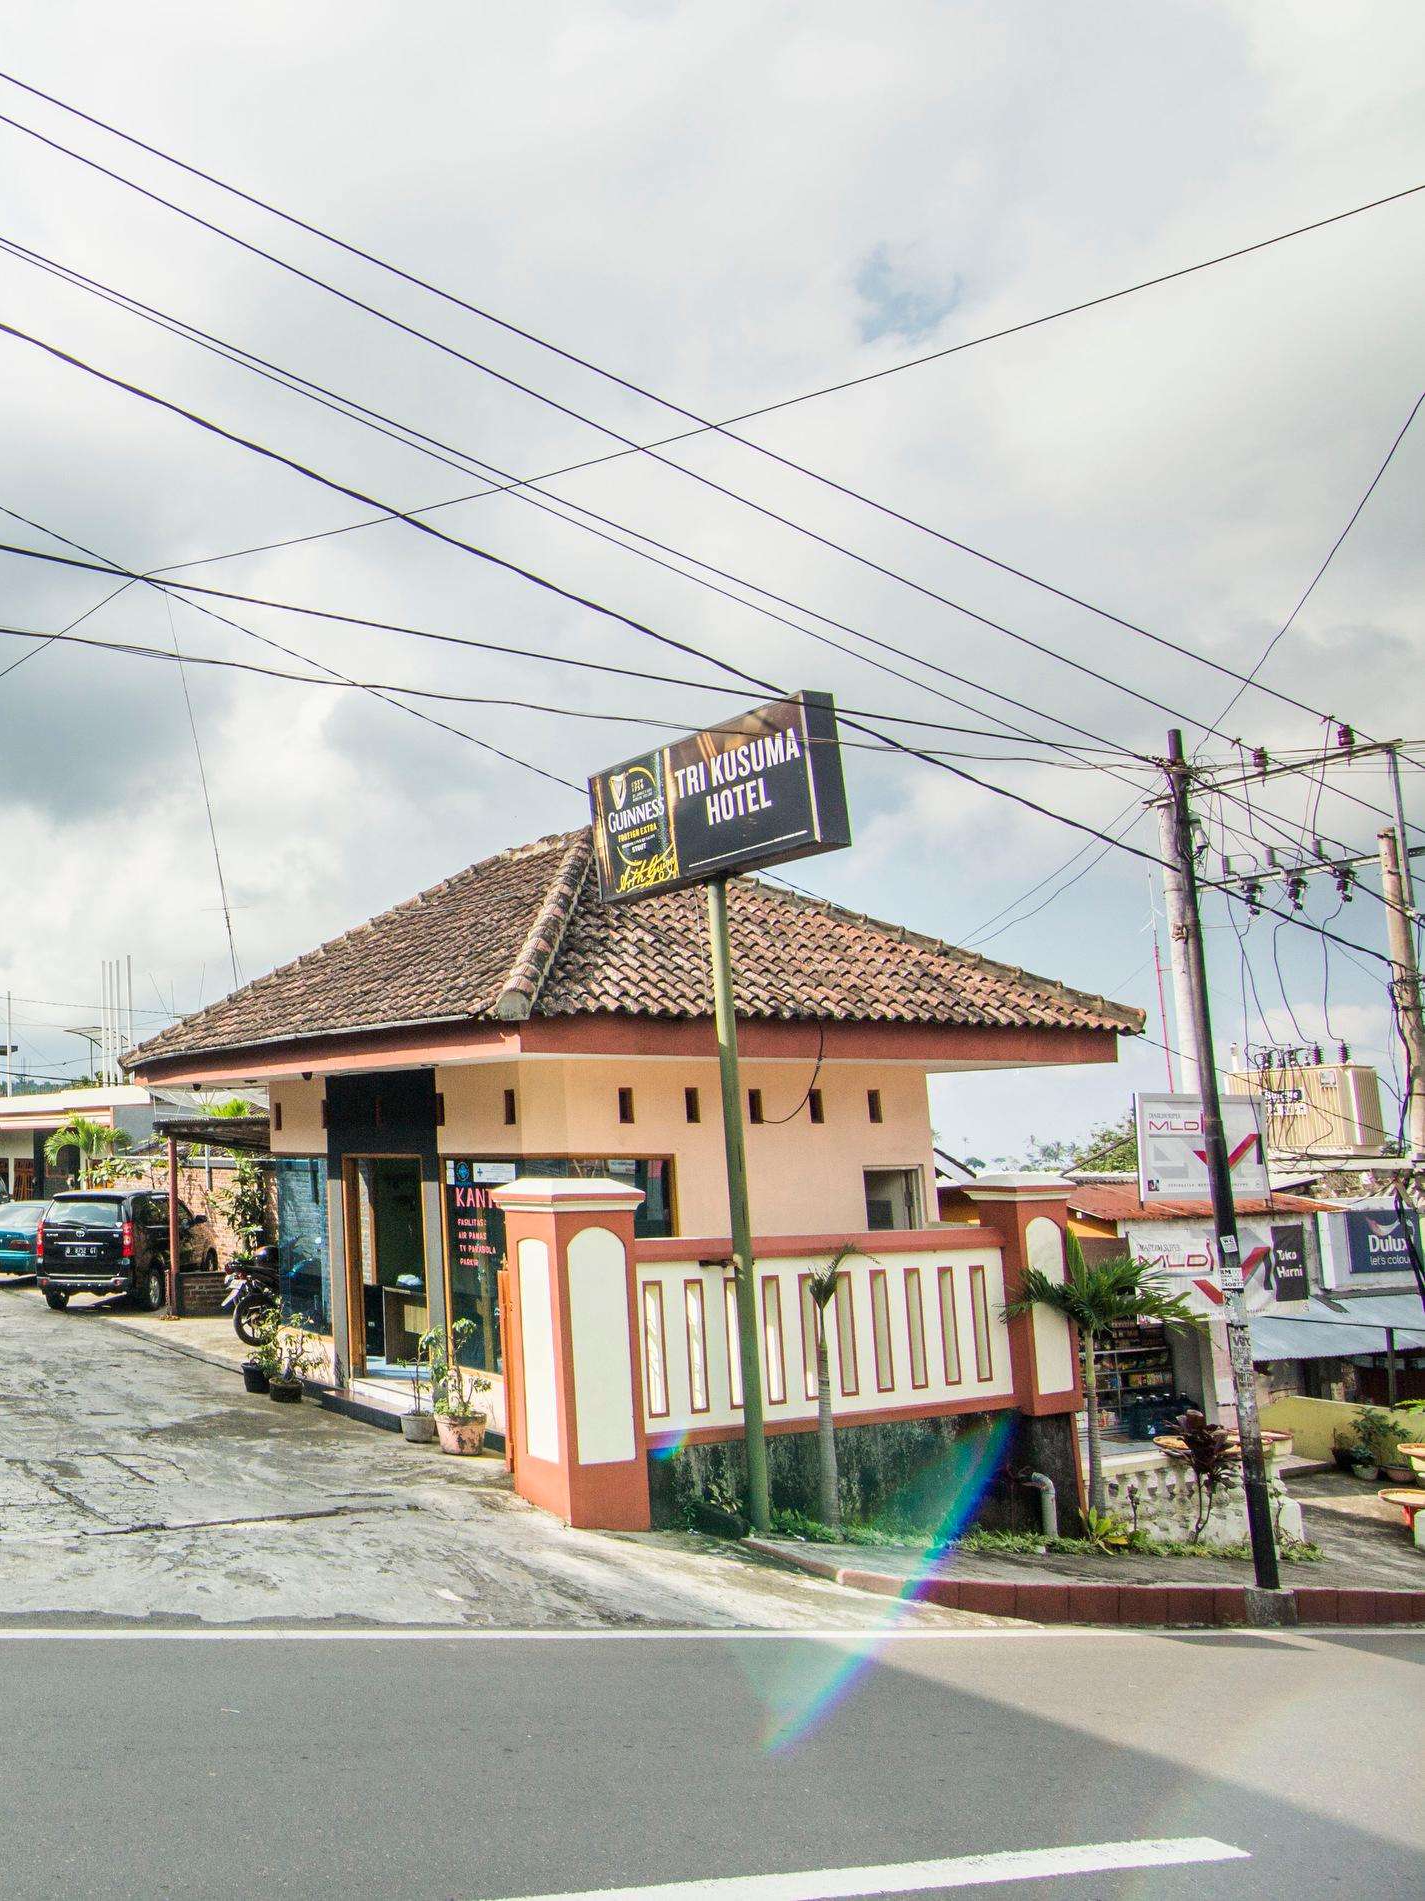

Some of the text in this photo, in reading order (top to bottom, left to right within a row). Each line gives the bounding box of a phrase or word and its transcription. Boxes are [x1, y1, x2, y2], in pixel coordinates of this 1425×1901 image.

[674, 727, 801, 799] TRI KUSUMA
[706, 777, 772, 826] HOTEL
[608, 797, 665, 833] GUINNESS
[640, 822, 658, 835] EXTRA
[1149, 1121, 1199, 1130] MLD
[1368, 1234, 1408, 1252] Dulux
[1388, 1254, 1411, 1264] colou
